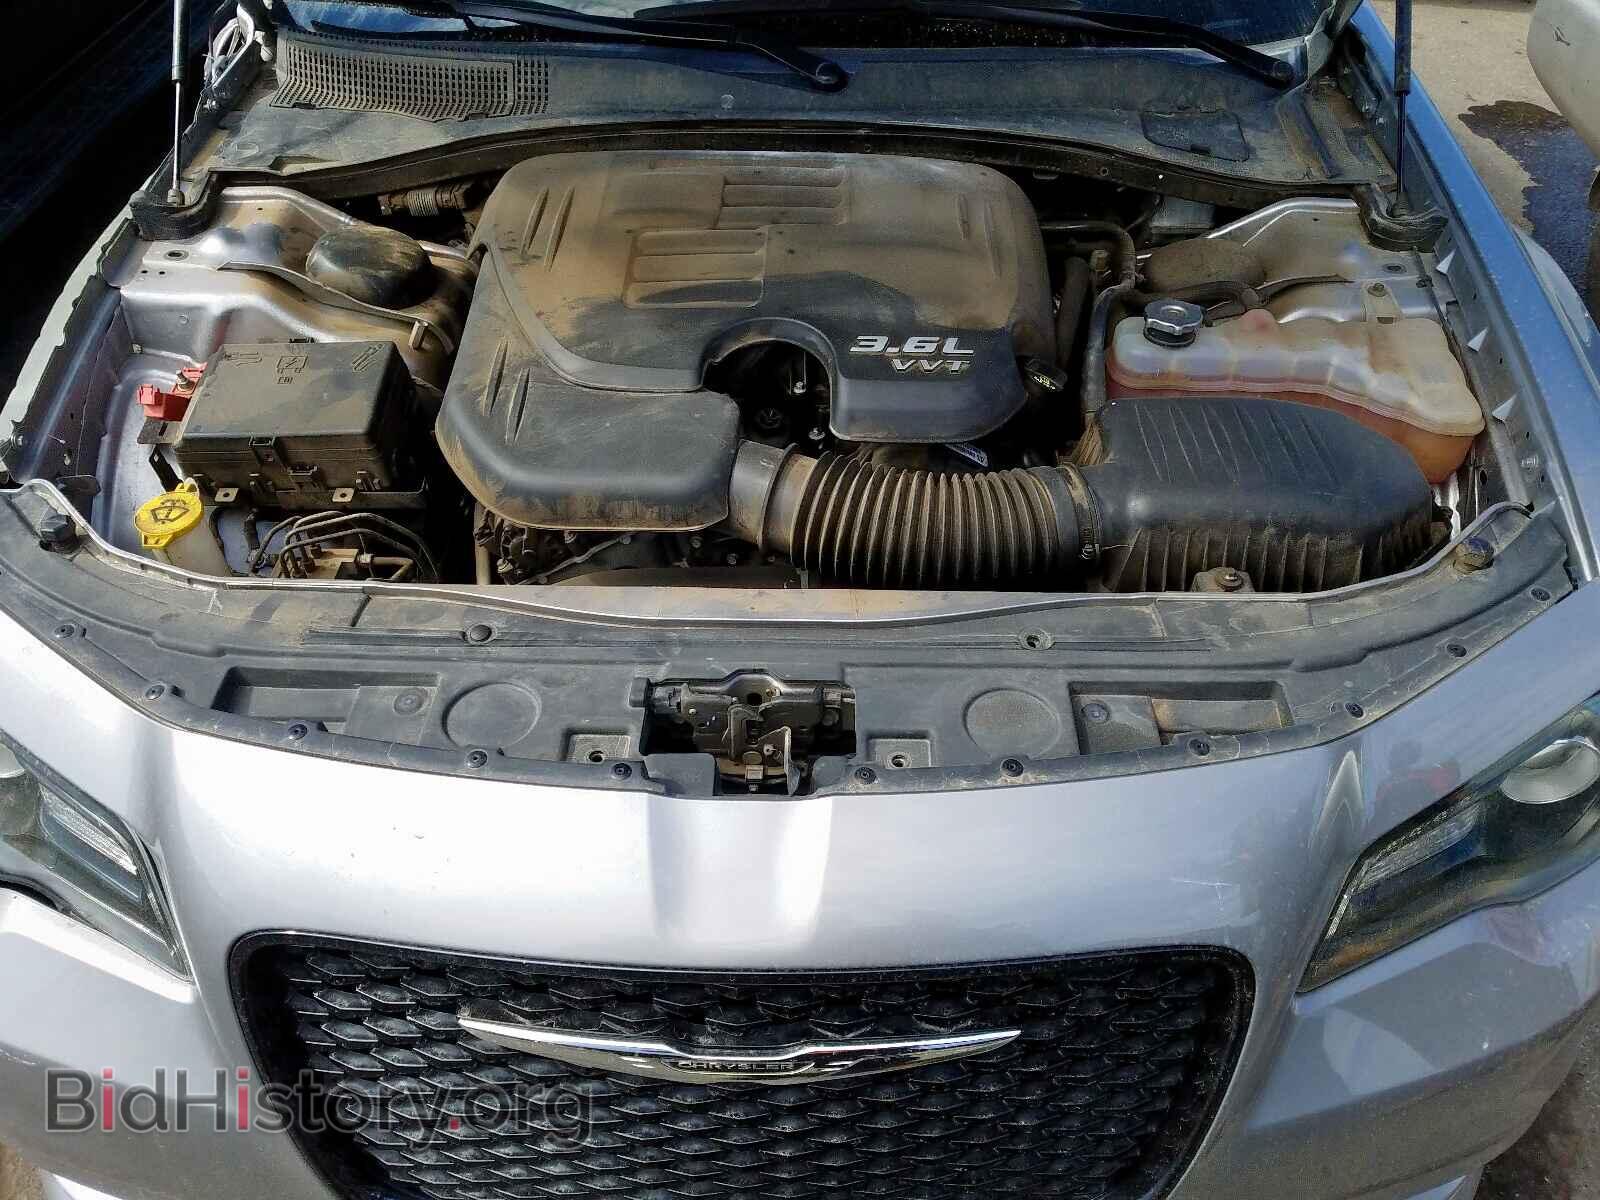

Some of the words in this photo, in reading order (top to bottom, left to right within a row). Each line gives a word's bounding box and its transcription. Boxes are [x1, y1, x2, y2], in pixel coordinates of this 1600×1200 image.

[850, 335, 975, 355] 3.6L
[891, 358, 970, 374] VVT
[677, 1059, 794, 1071] CHRYSLER
